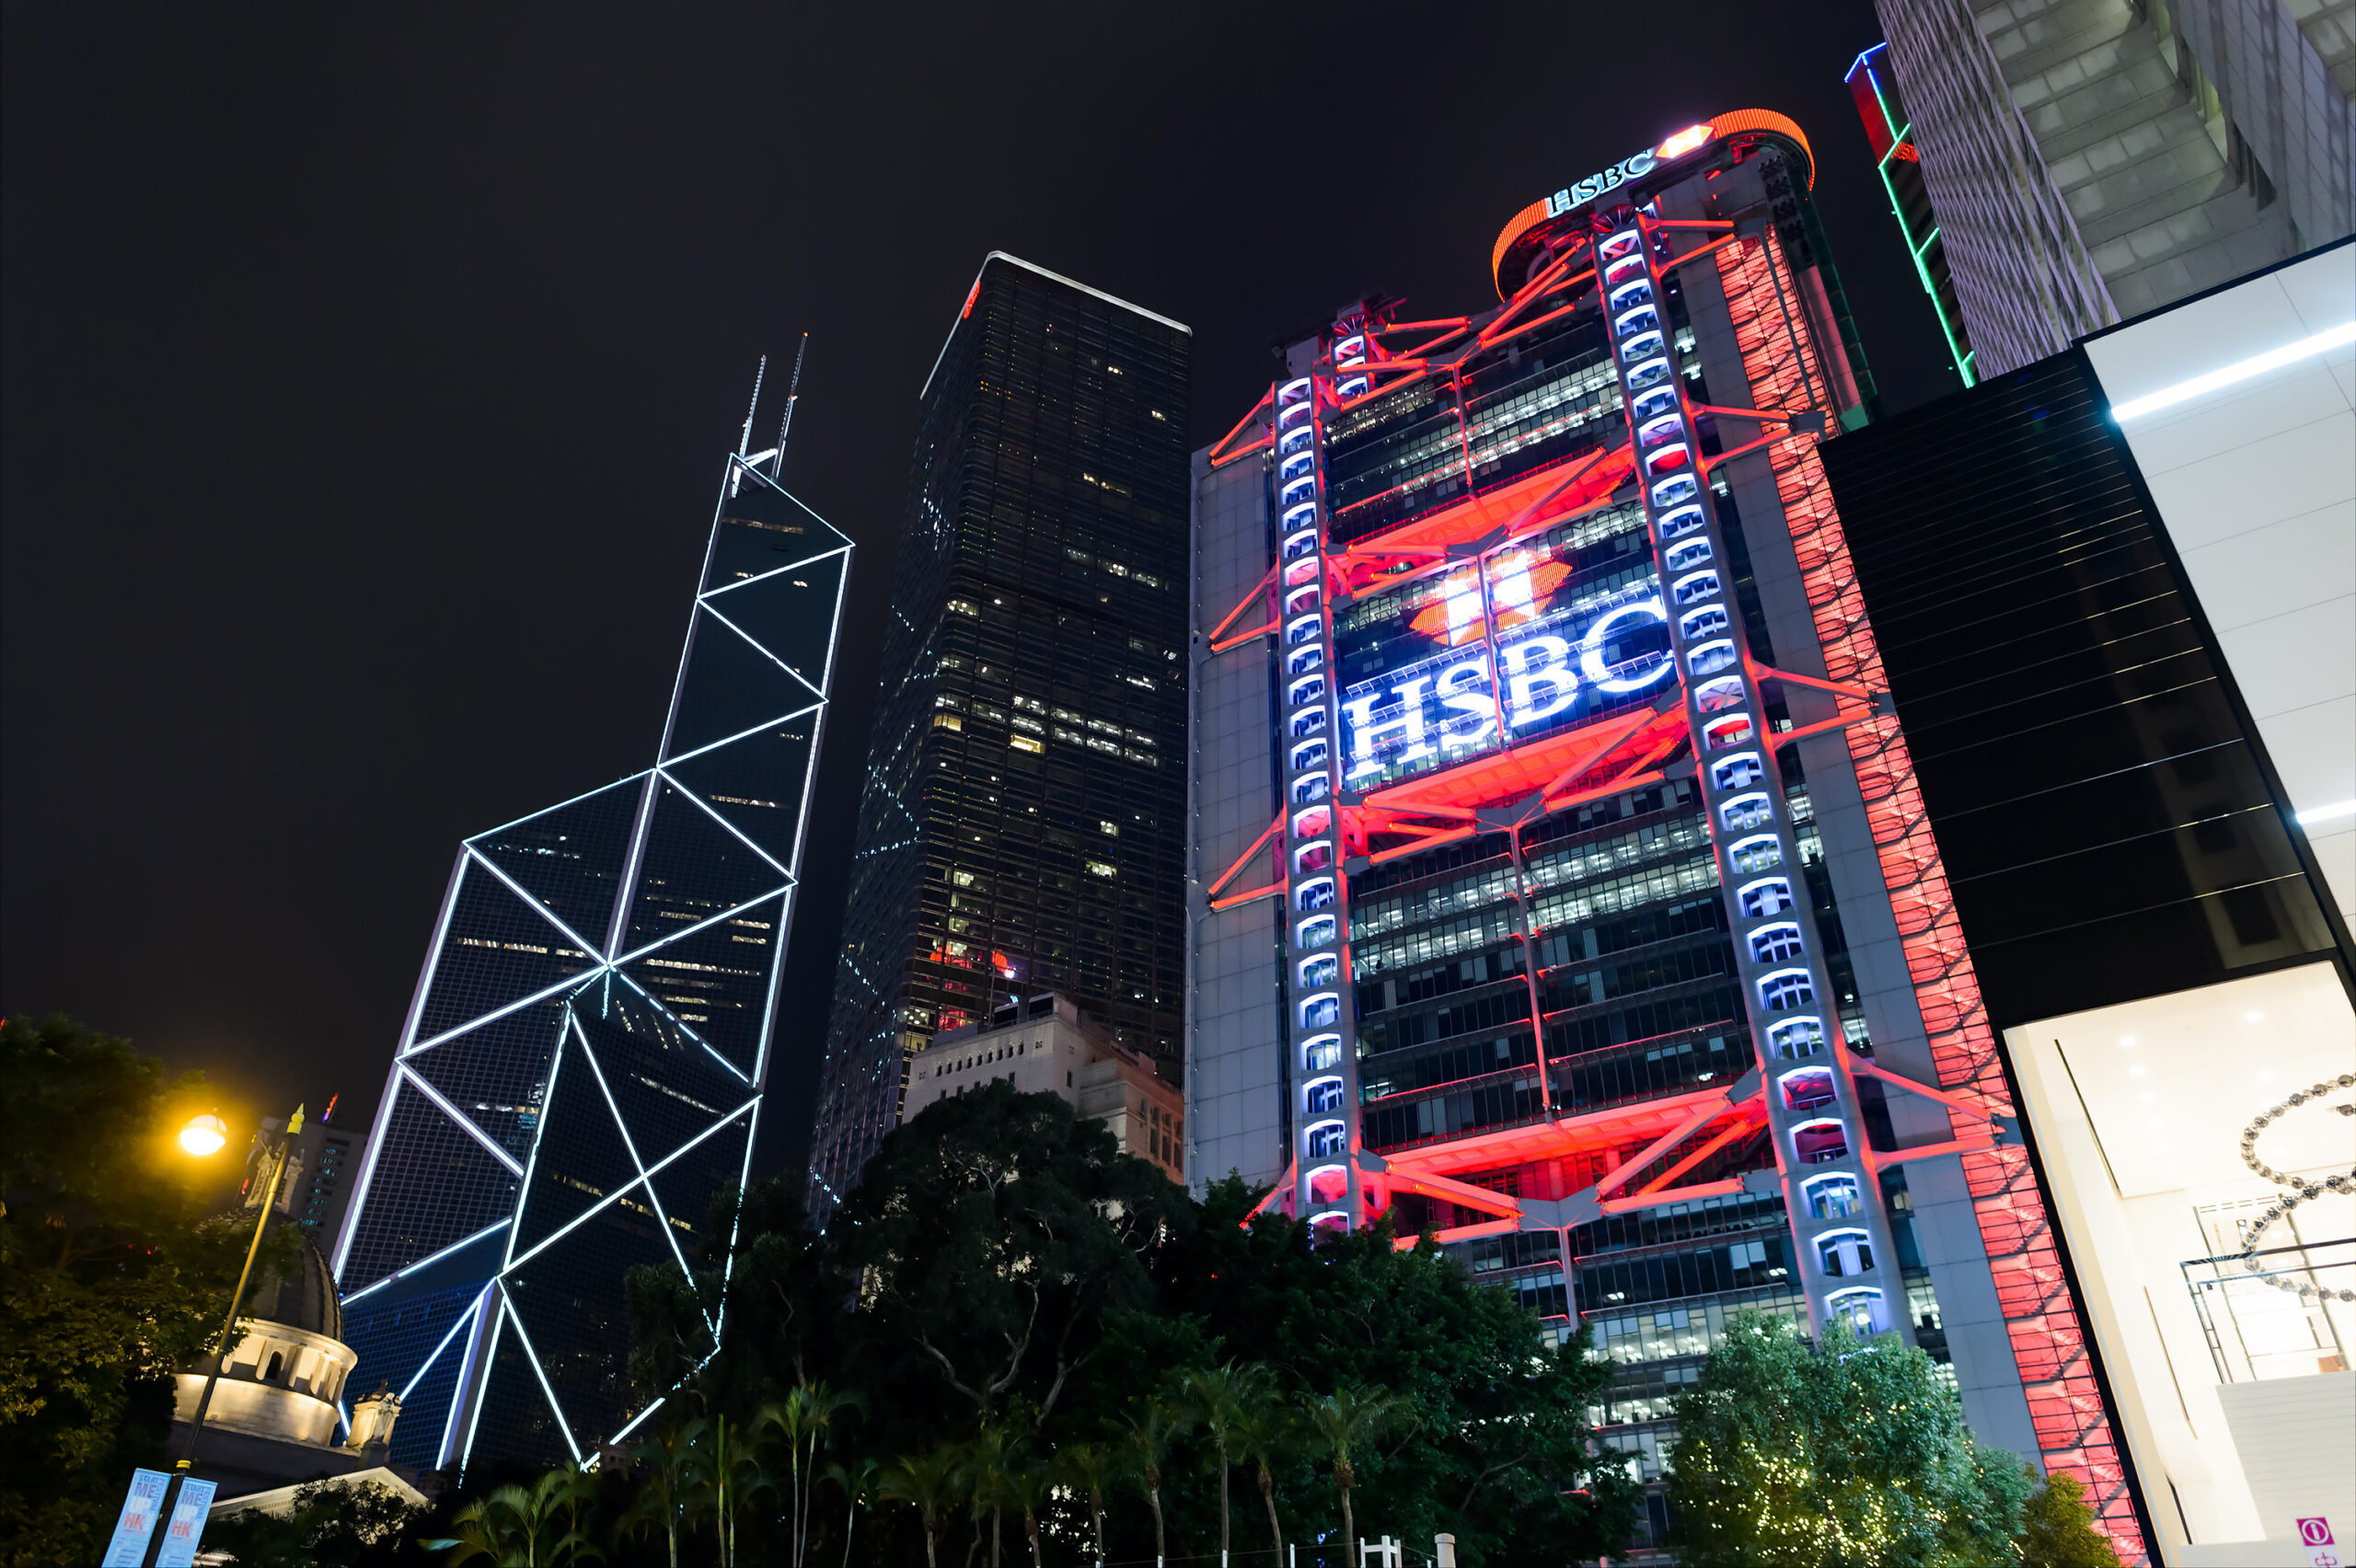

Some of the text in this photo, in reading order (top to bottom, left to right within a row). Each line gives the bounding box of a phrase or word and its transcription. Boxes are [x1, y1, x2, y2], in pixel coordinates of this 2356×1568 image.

[1546, 149, 1656, 217] HSBC
[1341, 594, 1675, 780] HSBC
[133, 1482, 157, 1498] ME
[180, 1491, 203, 1505] ME
[129, 1495, 153, 1513] UP
[122, 1512, 147, 1531] HK
[170, 1520, 193, 1538] HK
